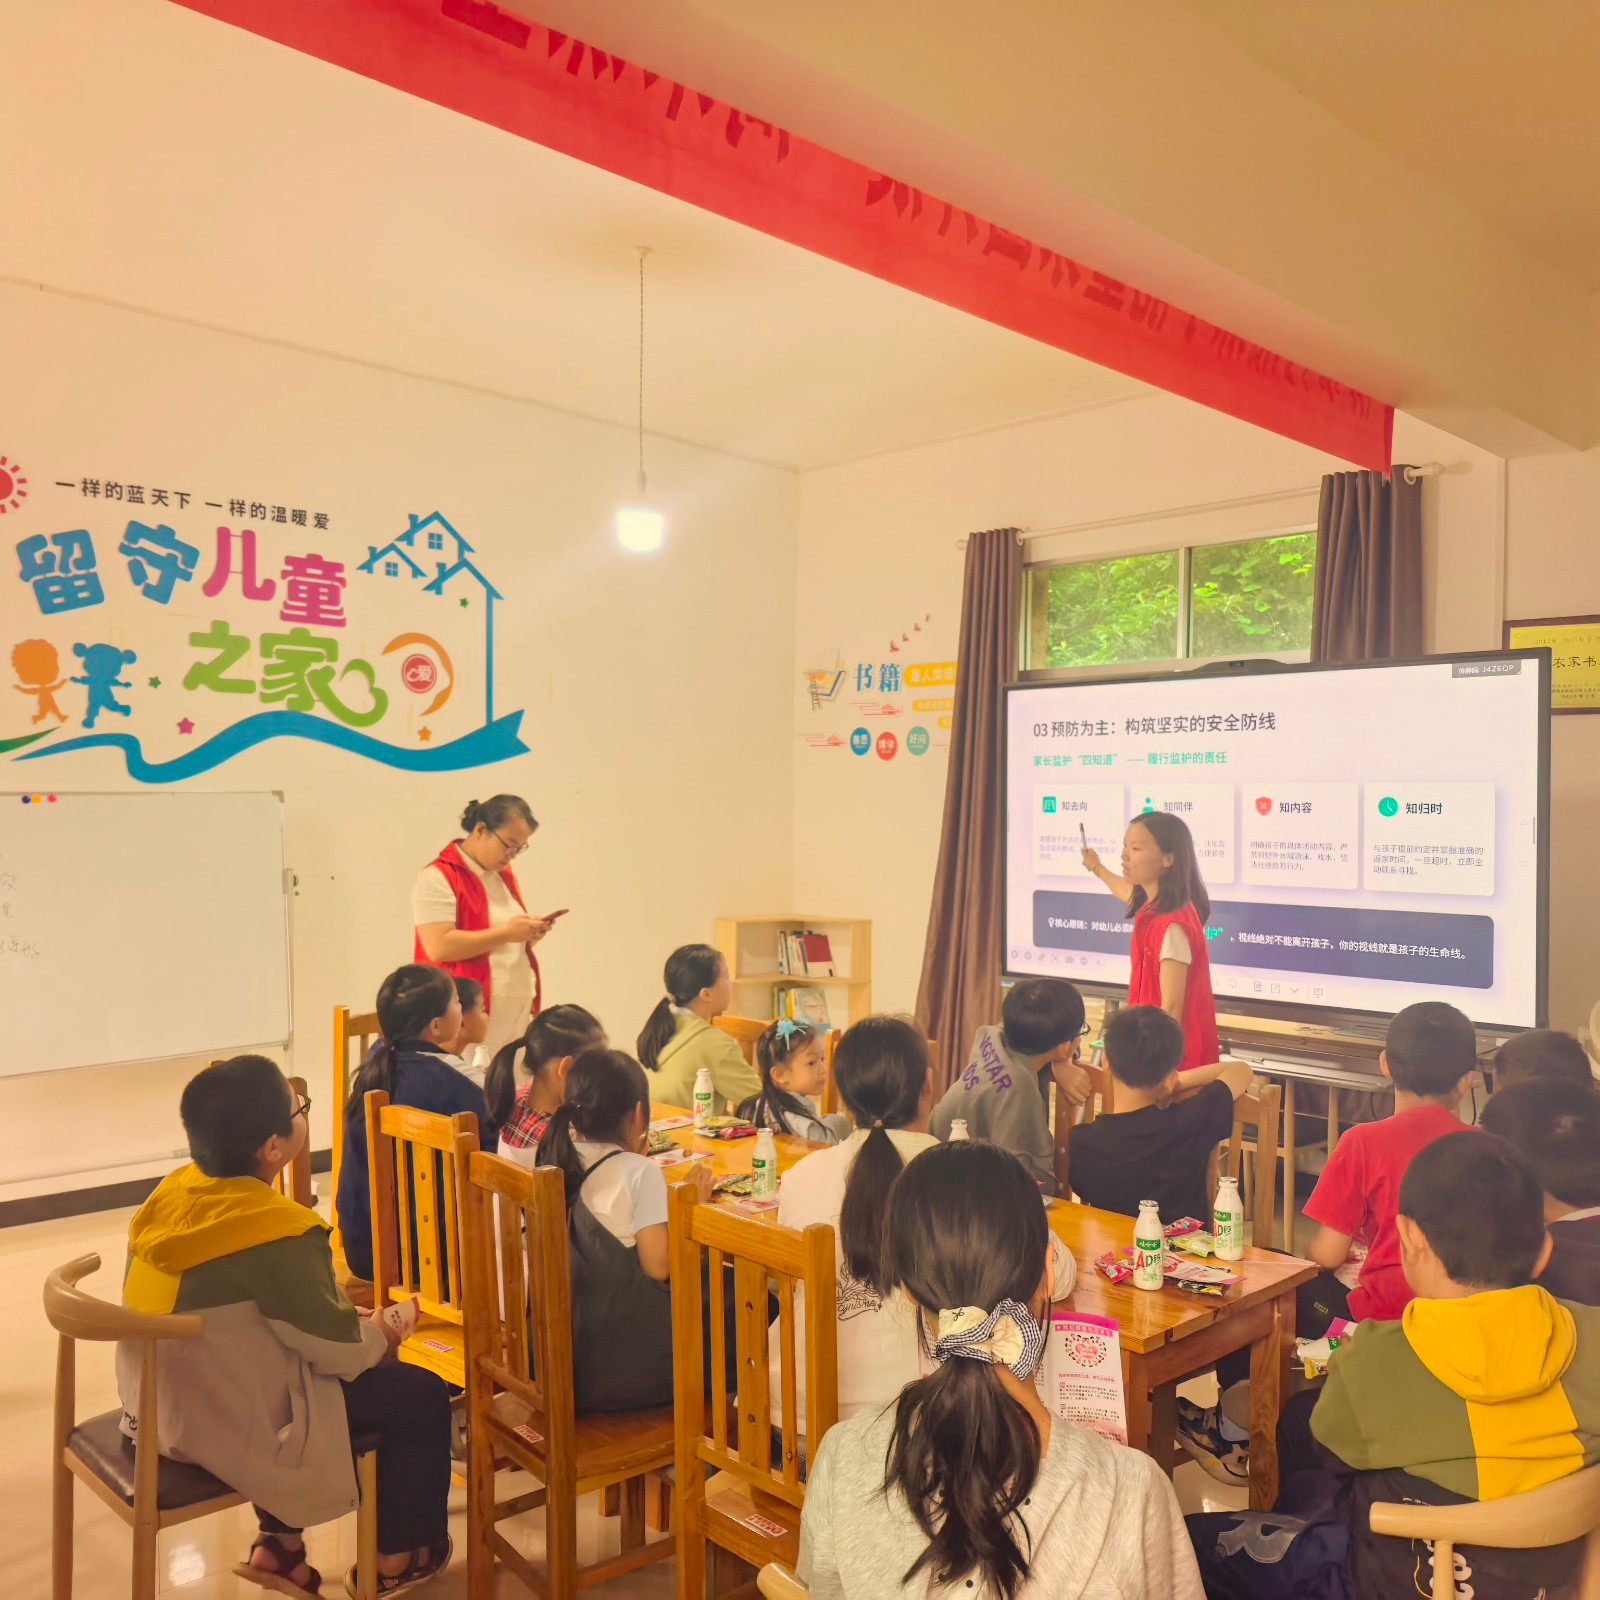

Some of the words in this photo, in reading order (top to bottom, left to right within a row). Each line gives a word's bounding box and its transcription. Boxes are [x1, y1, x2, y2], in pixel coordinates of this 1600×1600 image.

[55, 478, 191, 509] 一样的蓝天下
[205, 499, 330, 531] 一样的温暖爱
[15, 520, 347, 628] 留守儿童
[1552, 655, 1600, 669] 农家书
[182, 619, 388, 727] 之家
[855, 662, 901, 693] 书籍
[1033, 722, 1048, 738] 03
[1061, 801, 1088, 812] 知去向
[1164, 801, 1194, 813] 知同伴
[1279, 801, 1312, 814] 知内容
[1405, 802, 1443, 816] 知归时
